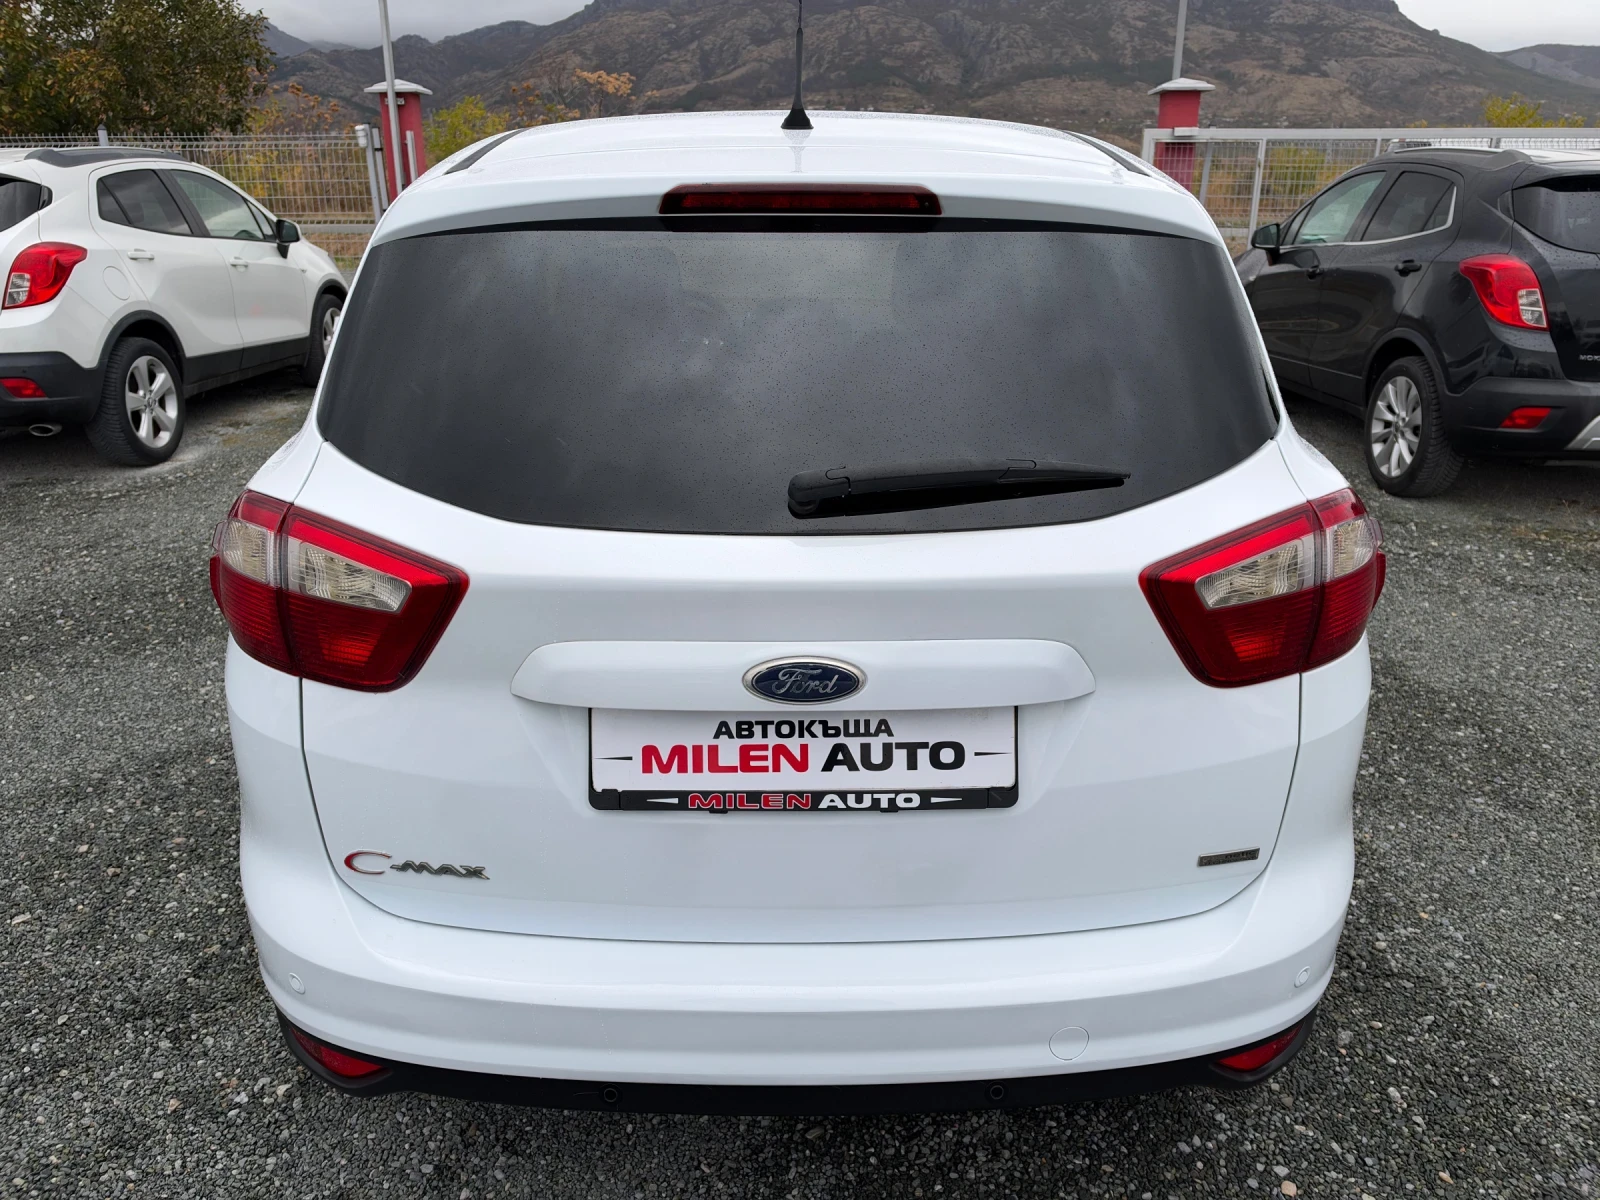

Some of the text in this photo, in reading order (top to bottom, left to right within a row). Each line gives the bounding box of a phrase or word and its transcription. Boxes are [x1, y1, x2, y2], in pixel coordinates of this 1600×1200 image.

[771, 668, 839, 694] Ford
[713, 719, 894, 740] АВТОКЪЩА
[641, 741, 966, 774] MILEN AUTO
[687, 793, 921, 810] MILEN AUTO
